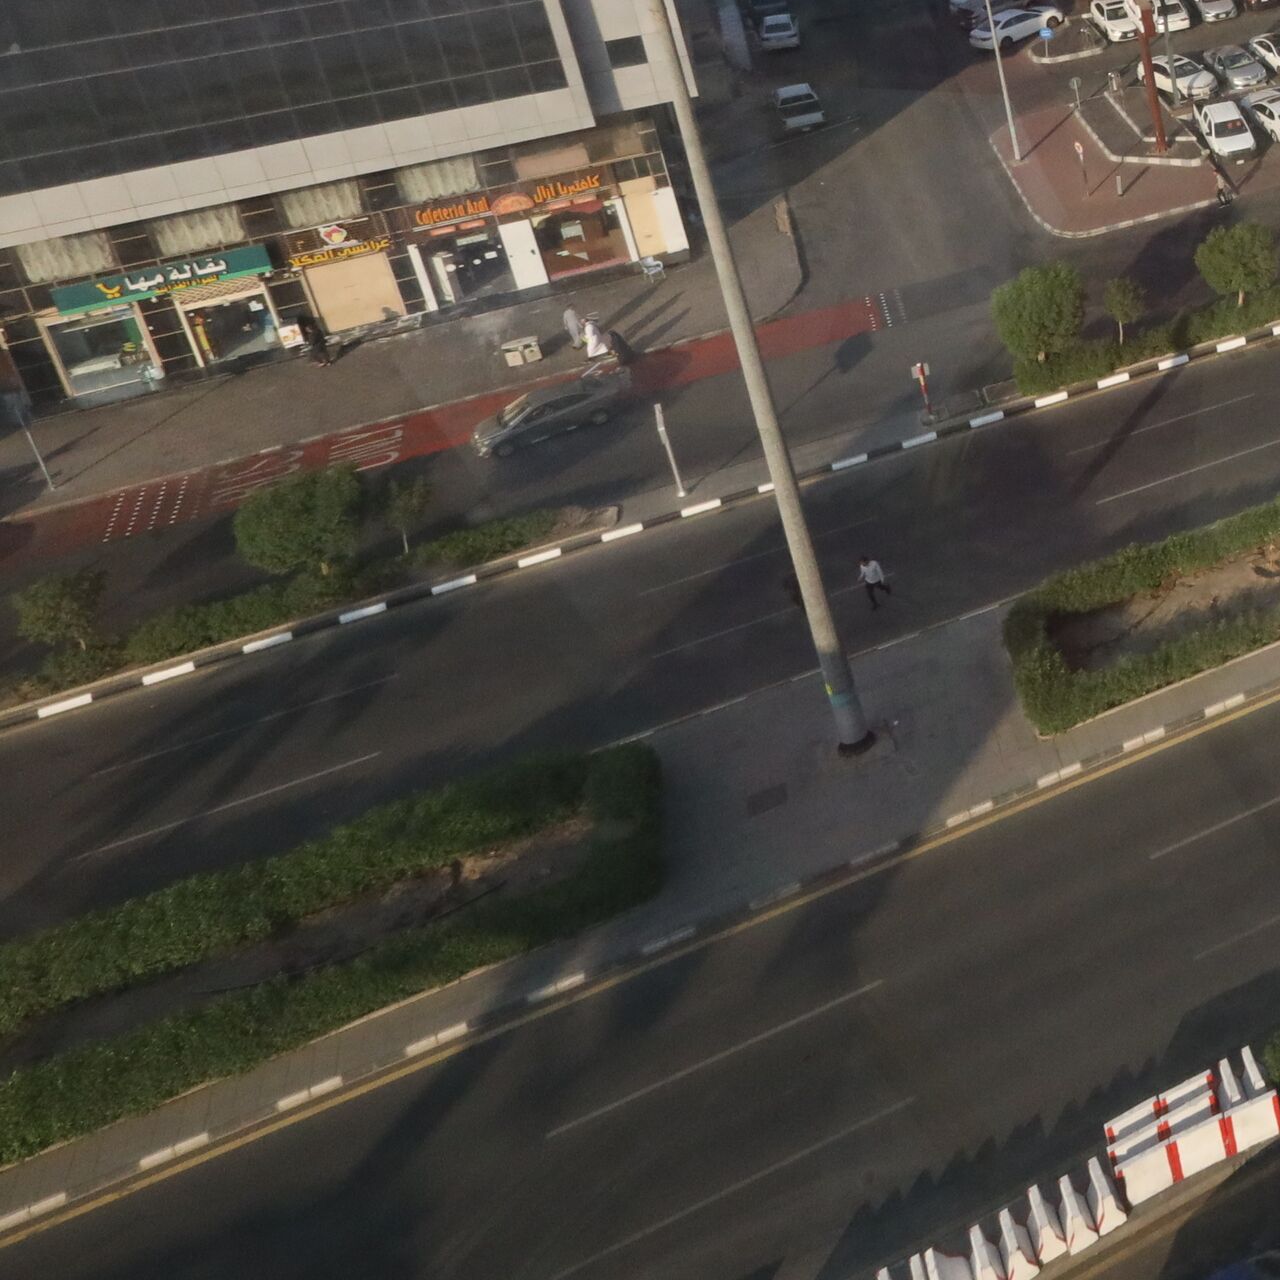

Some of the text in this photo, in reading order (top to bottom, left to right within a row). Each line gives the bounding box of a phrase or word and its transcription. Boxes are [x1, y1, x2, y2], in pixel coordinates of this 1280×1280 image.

[415, 196, 490, 225] Cafeteria Azal
[125, 258, 228, 291] بقالة مها
